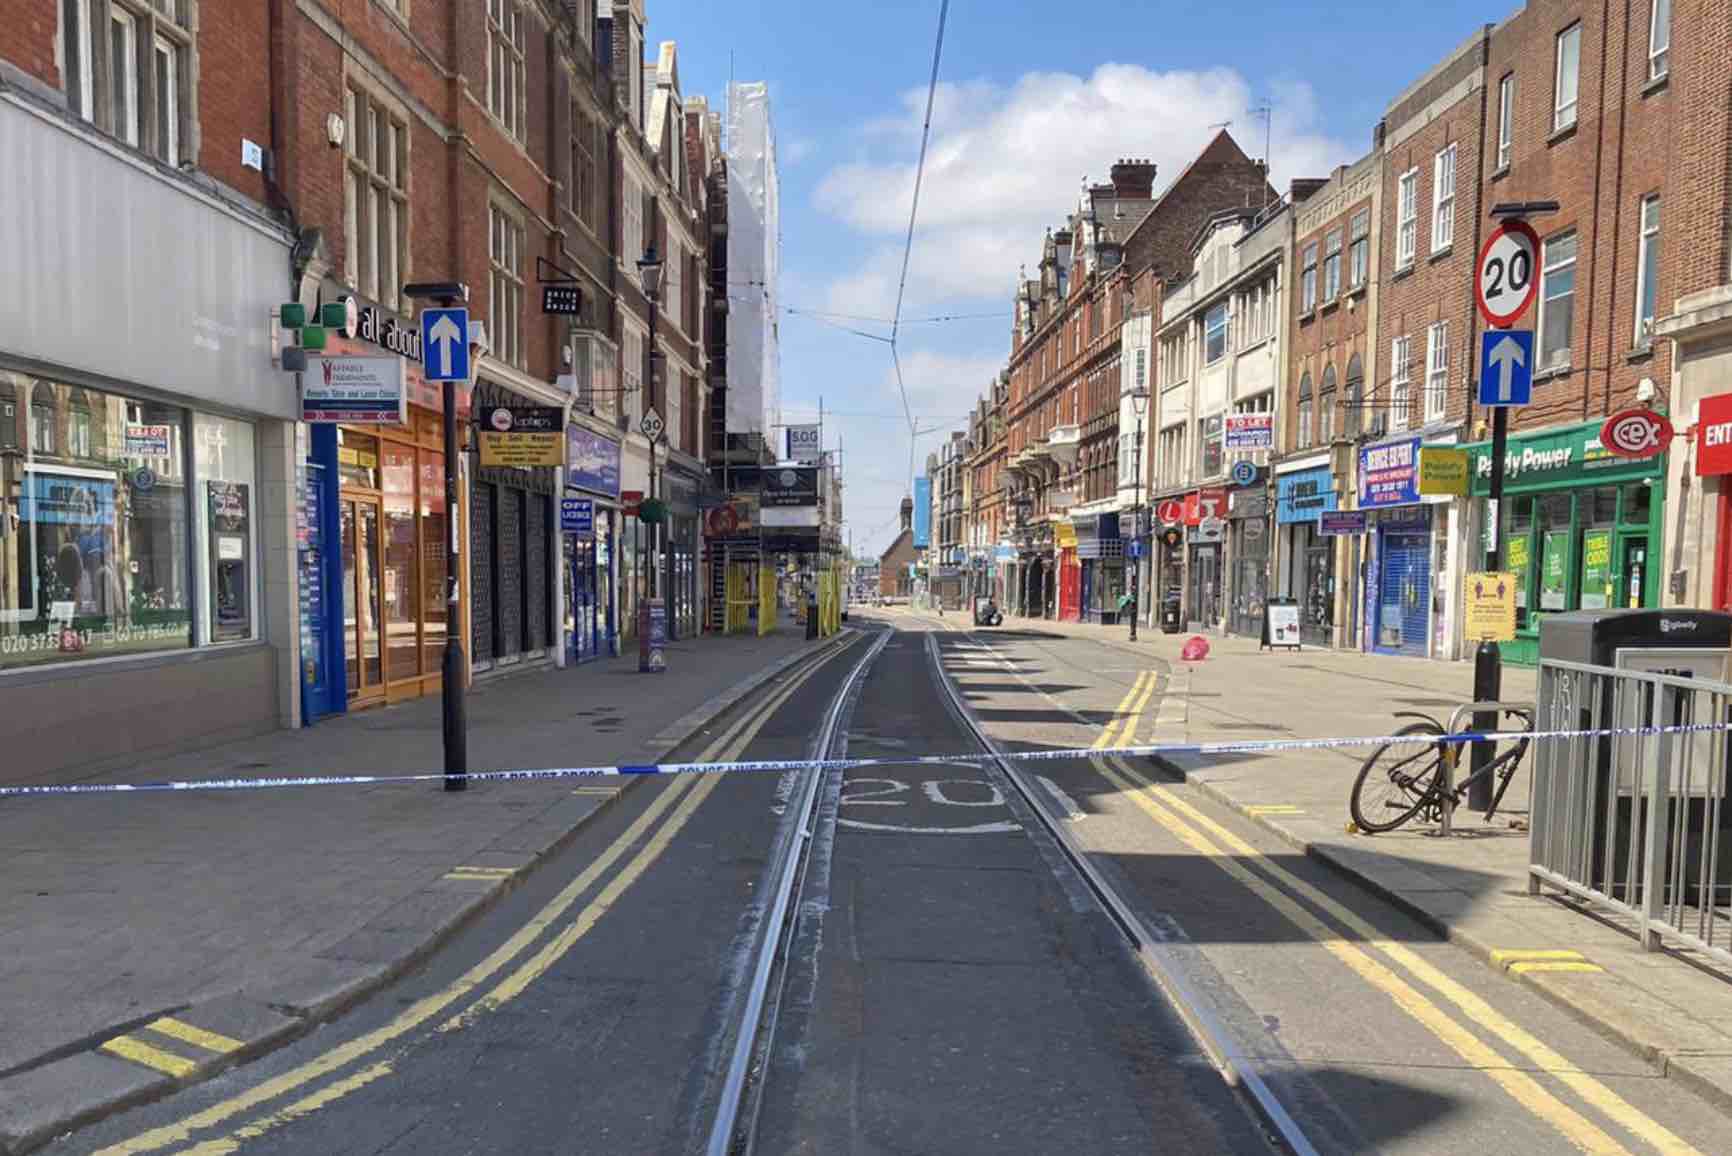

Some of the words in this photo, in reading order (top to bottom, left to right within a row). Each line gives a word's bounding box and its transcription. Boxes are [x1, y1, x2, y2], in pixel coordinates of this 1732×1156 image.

[1485, 248, 1531, 300] 20
[362, 307, 380, 343] all
[644, 420, 662, 431] 30
[1523, 447, 1572, 470] Power
[562, 501, 591, 511] OFF
[840, 777, 1005, 807] 20
